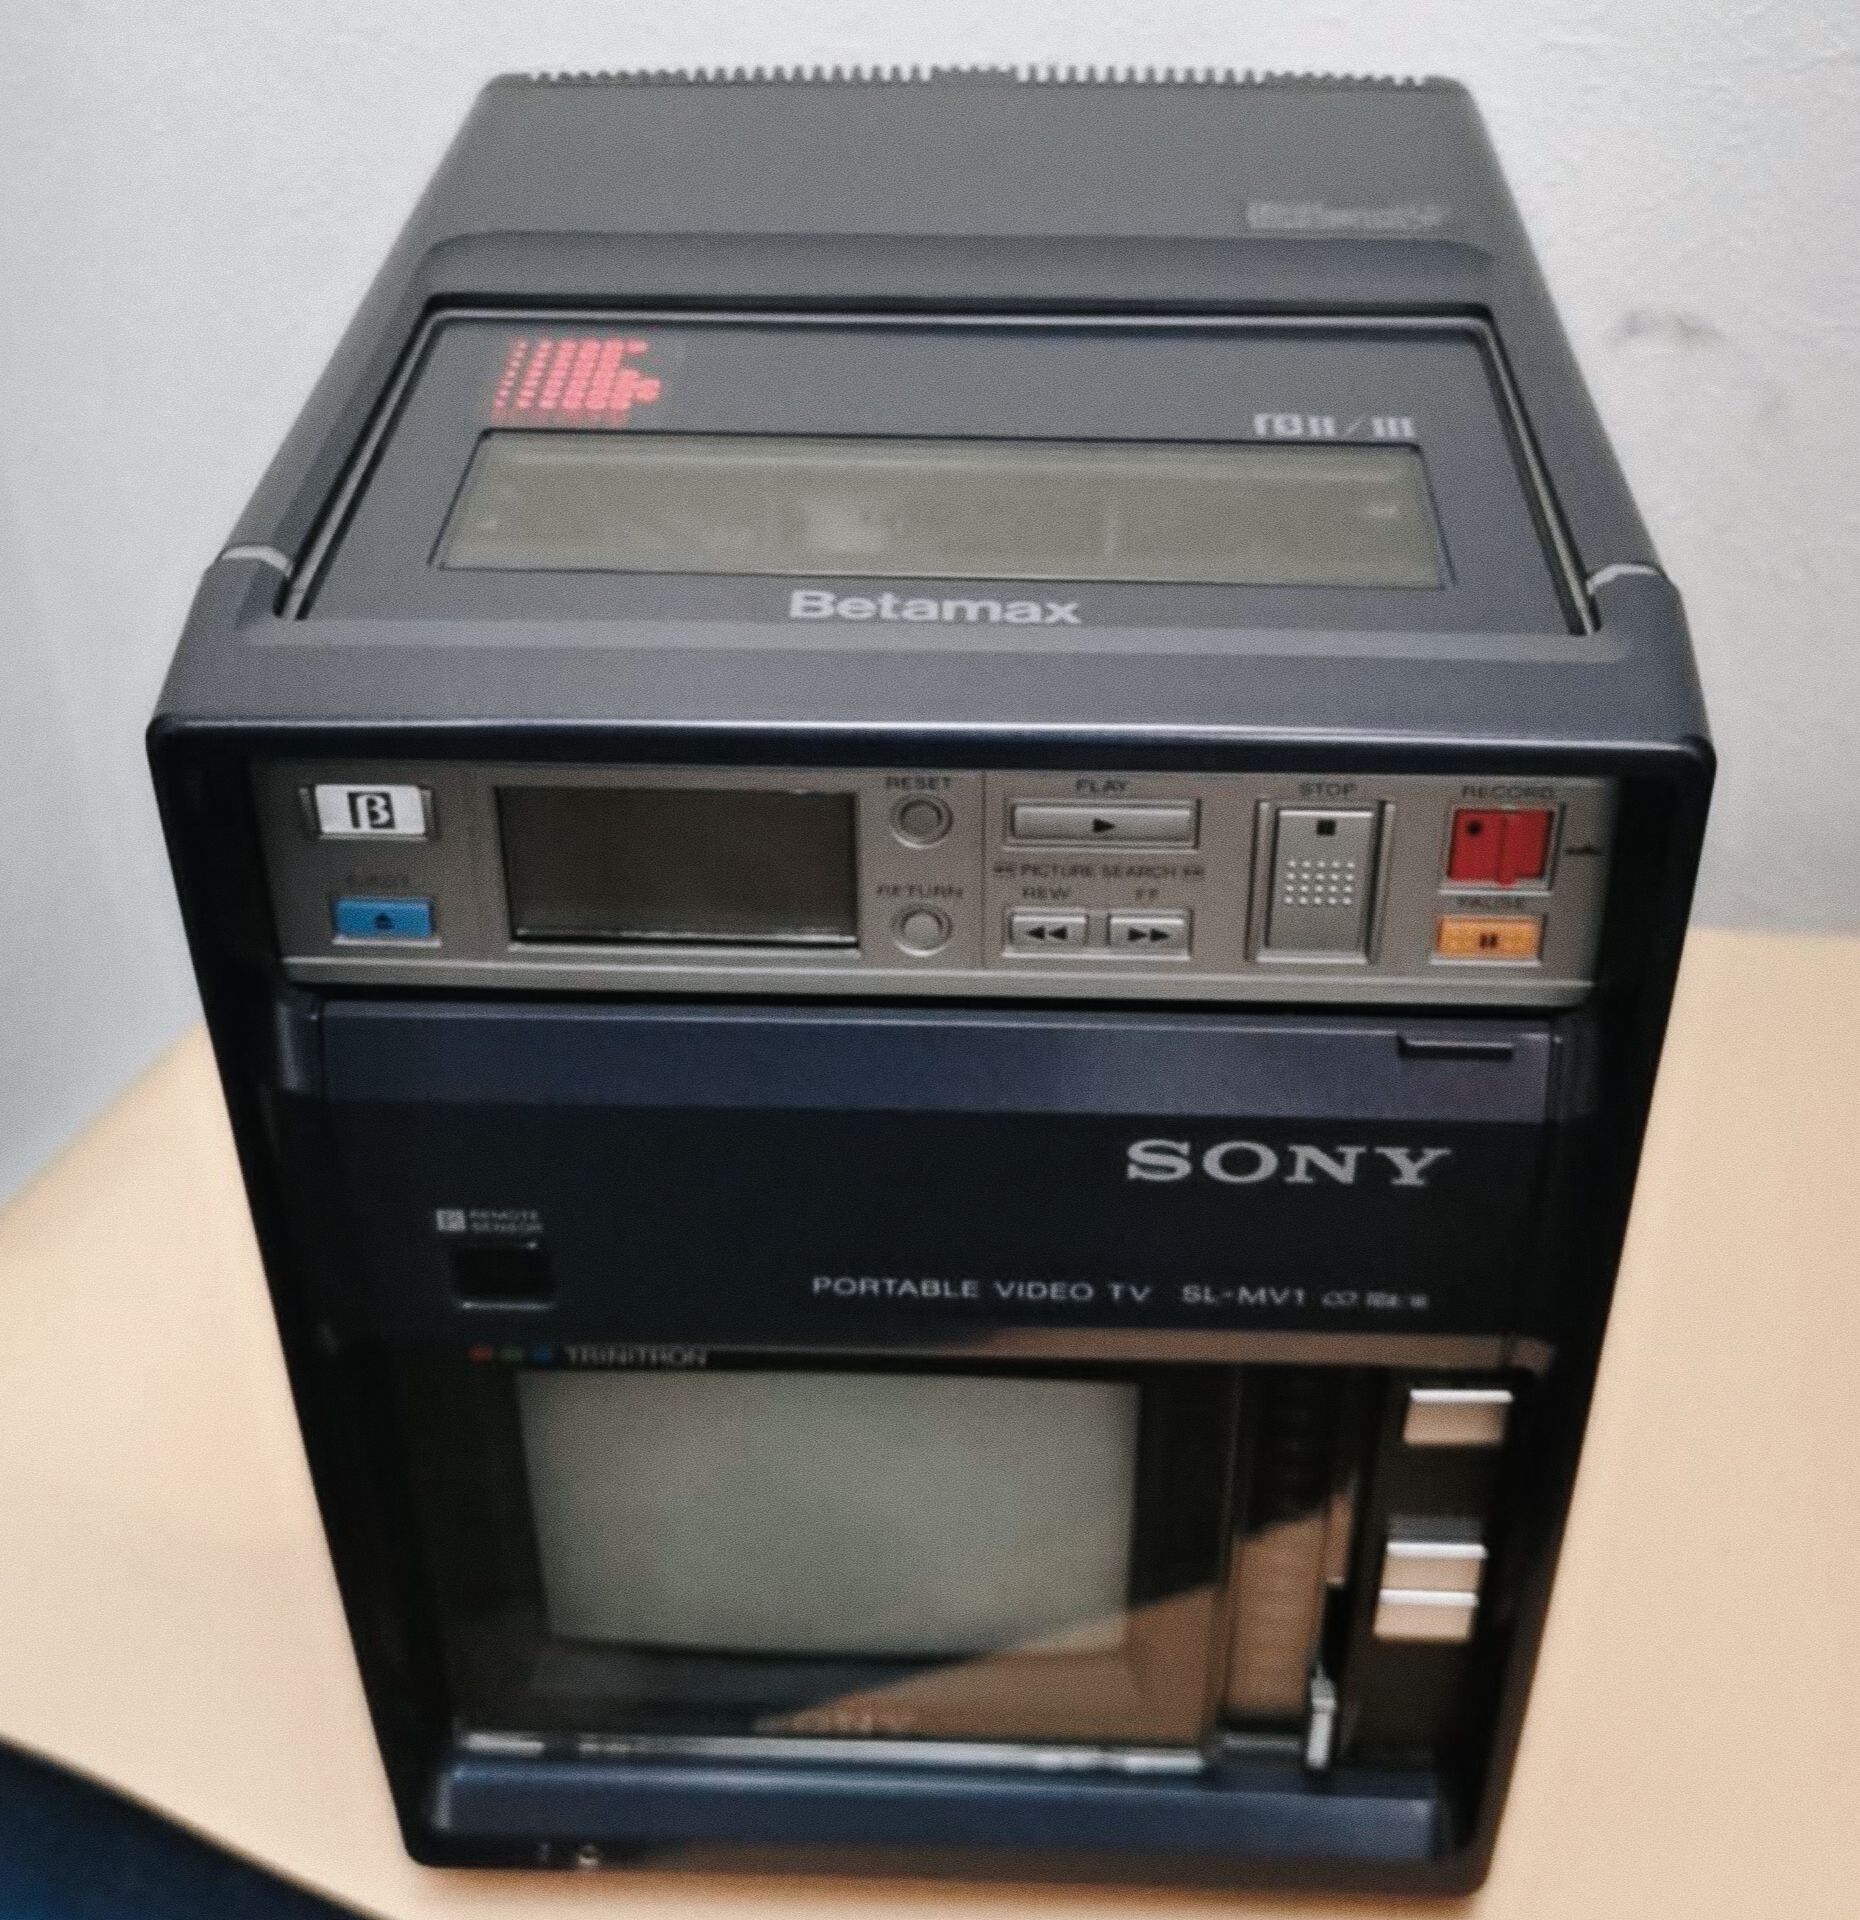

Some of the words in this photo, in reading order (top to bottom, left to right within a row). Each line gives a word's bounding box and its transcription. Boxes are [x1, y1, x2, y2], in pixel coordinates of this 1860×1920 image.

[789, 588, 1082, 625] Betamax
[885, 776, 952, 790] RESET
[1075, 778, 1130, 793] PLAY
[1299, 782, 1357, 798] STOP
[1461, 784, 1554, 798] RECORD
[1020, 863, 1093, 879] PICTURE
[1102, 864, 1178, 879] SEARCH
[876, 884, 963, 898] RETURN
[1021, 885, 1073, 900] REW
[1126, 1138, 1451, 1186] SONY
[811, 1275, 980, 1299] PORTABLE
[993, 1279, 1095, 1301] VIDEO
[1107, 1282, 1151, 1301] TV
[1181, 1284, 1305, 1305] SL-MV1
[564, 1345, 708, 1366] TRINITRON
